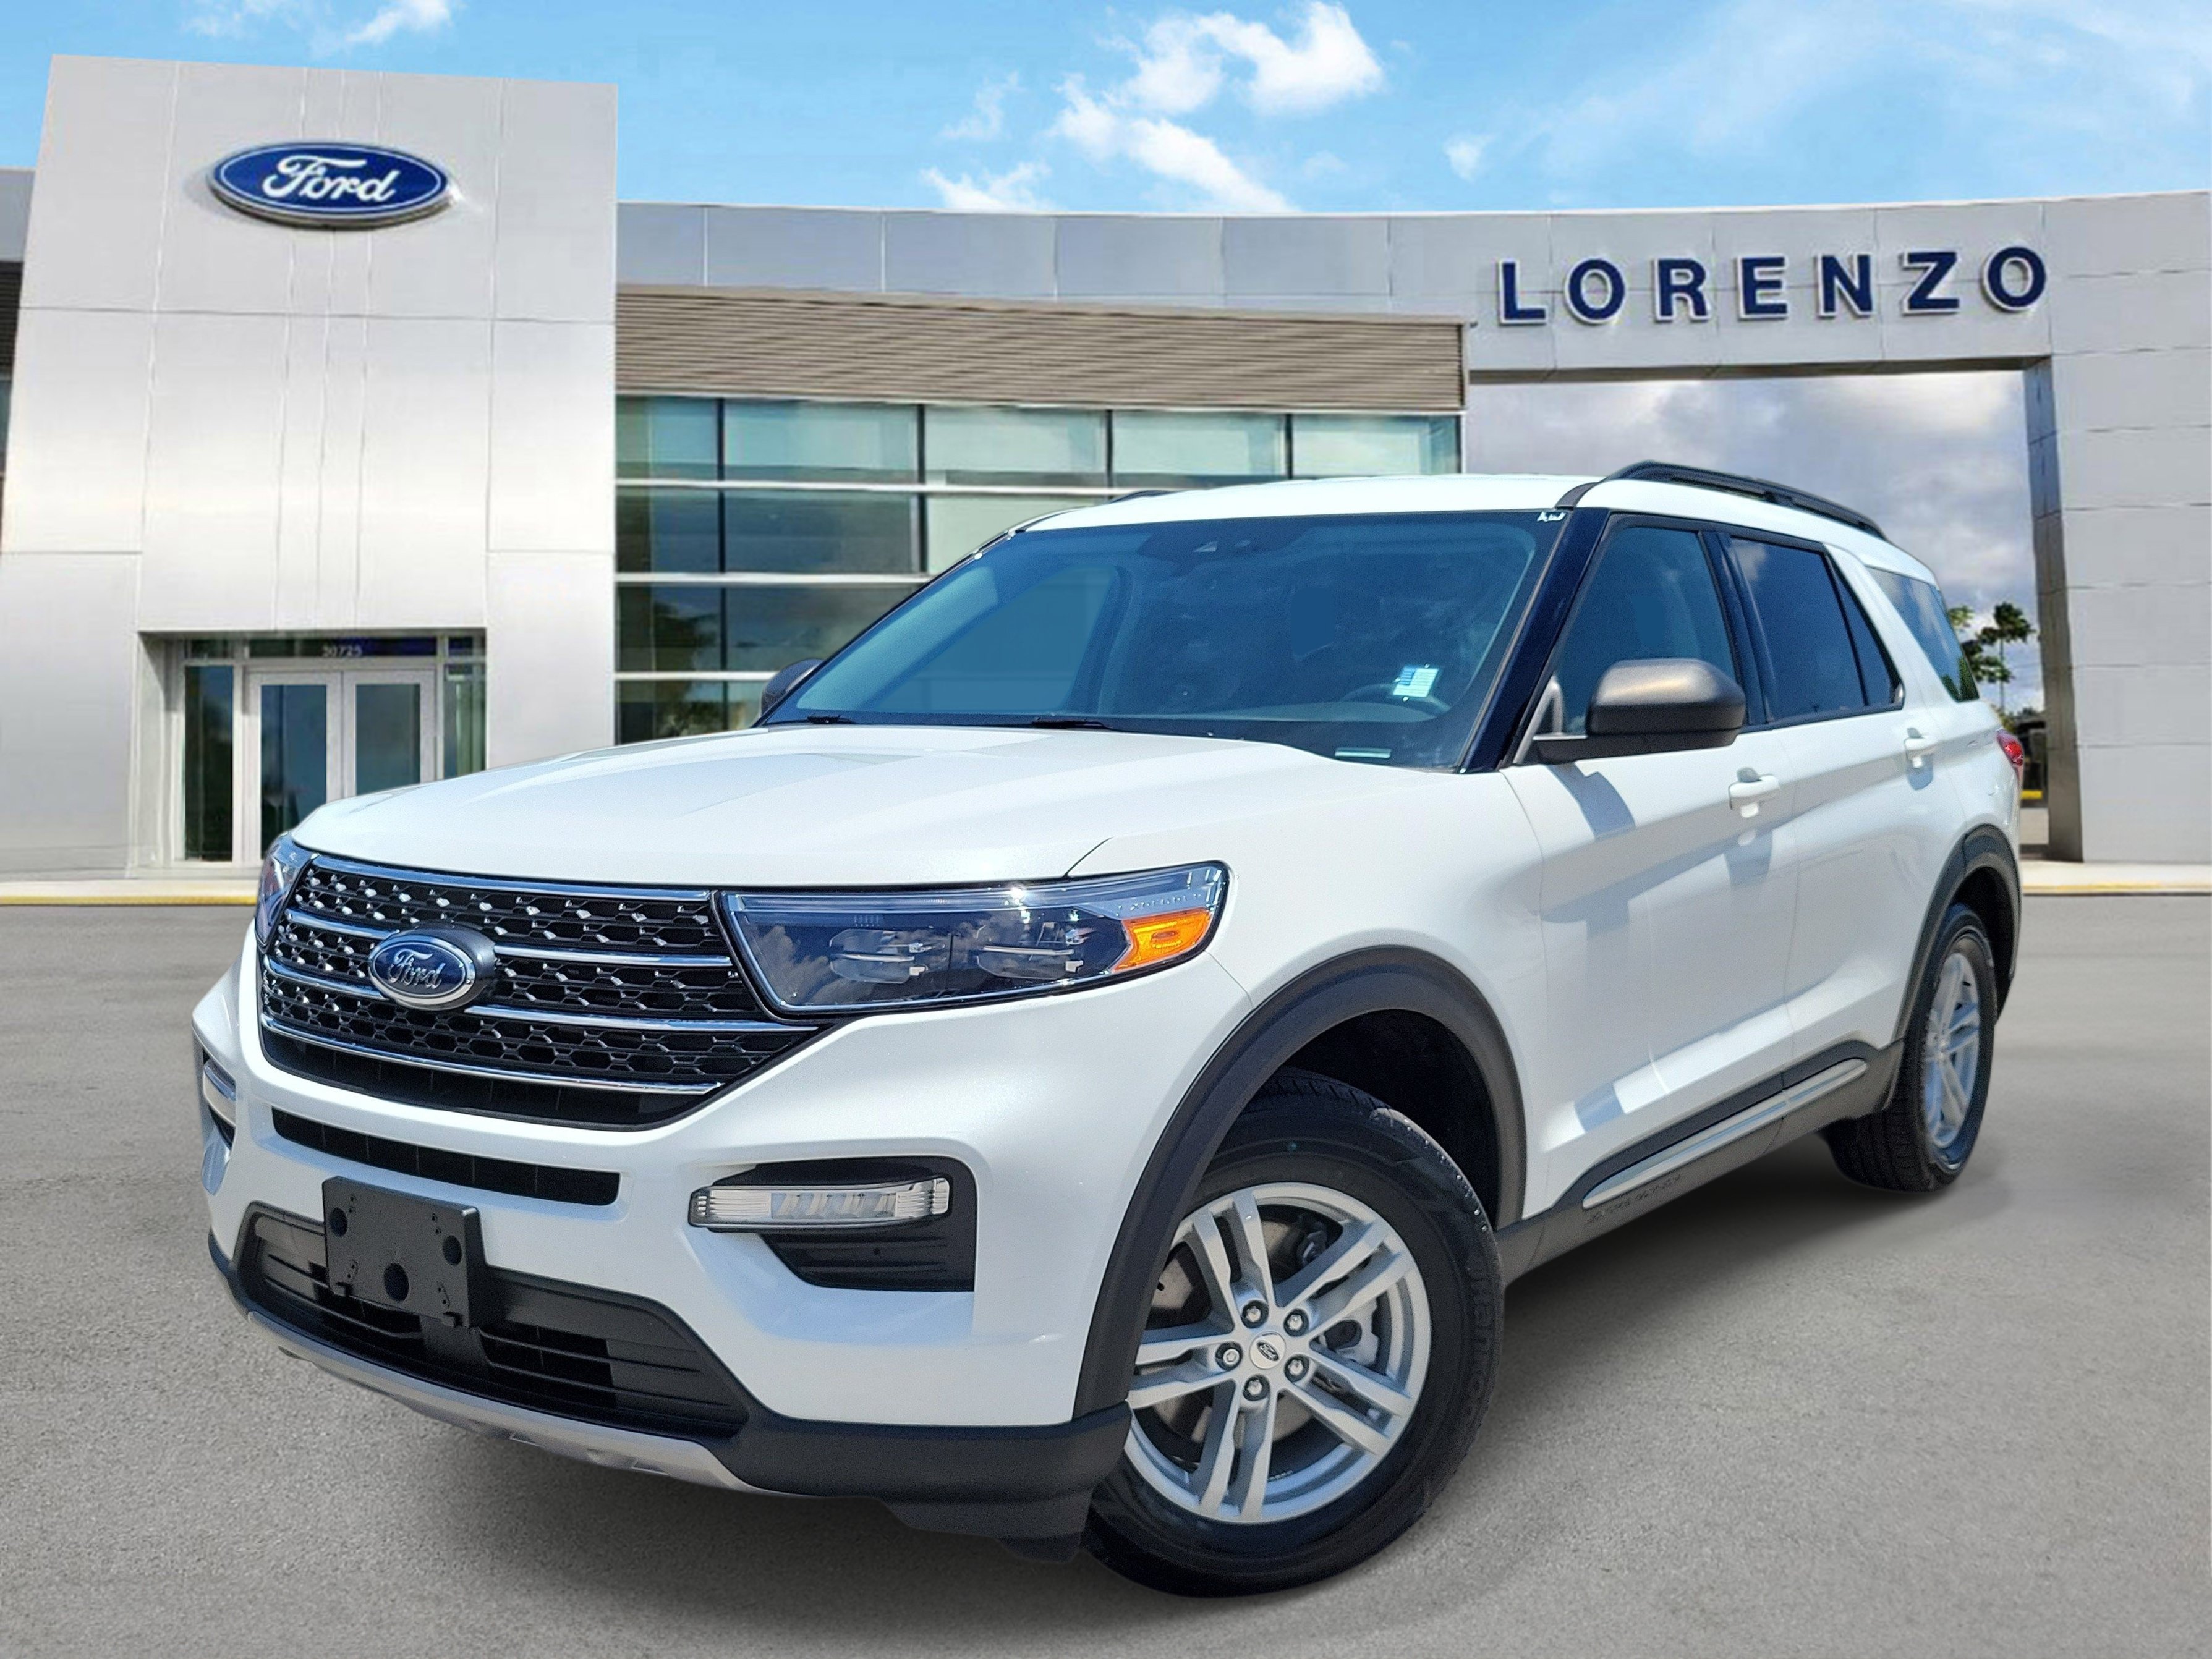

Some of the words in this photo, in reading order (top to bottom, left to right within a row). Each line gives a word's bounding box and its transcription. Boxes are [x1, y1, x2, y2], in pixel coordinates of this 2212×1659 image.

[262, 154, 401, 202] Ford
[1497, 247, 2048, 324] LORENZO
[387, 948, 446, 989] Ford
